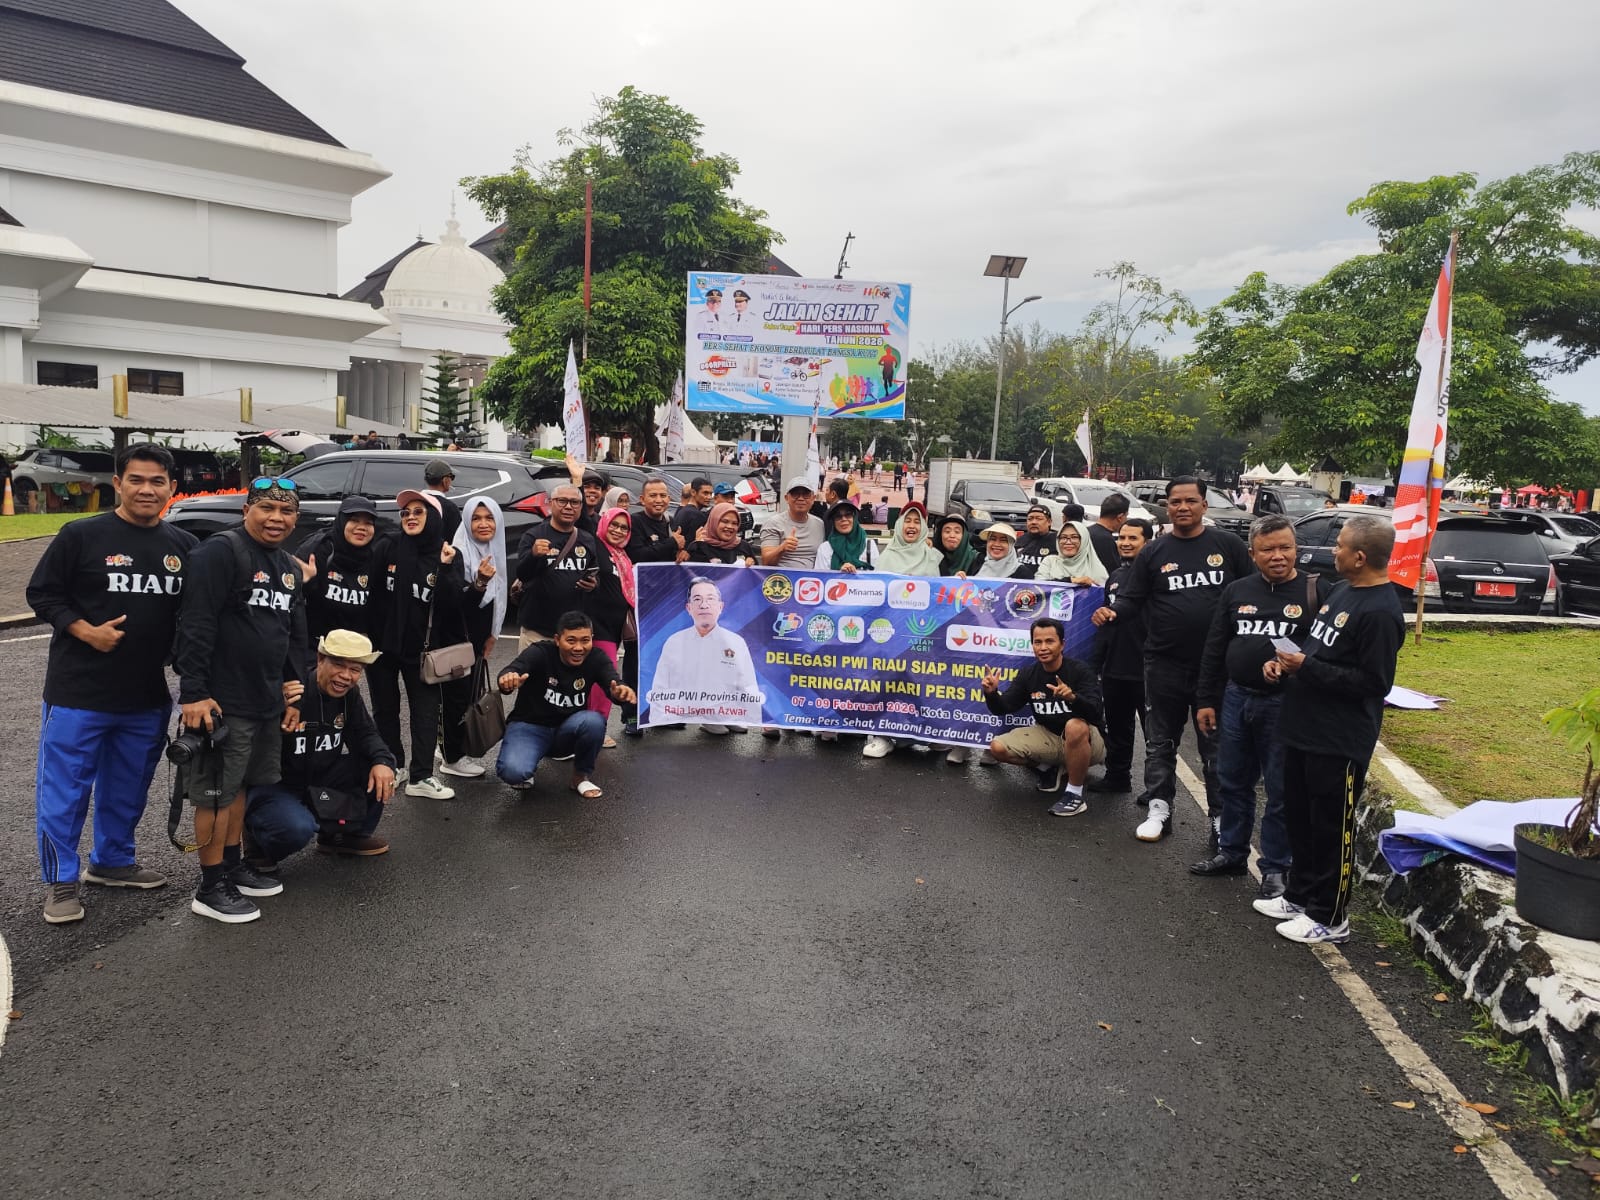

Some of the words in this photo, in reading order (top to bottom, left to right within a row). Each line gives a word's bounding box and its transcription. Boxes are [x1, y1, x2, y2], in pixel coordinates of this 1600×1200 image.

[763, 303, 821, 321] JALAN
[822, 303, 879, 322] SEHAT
[800, 324, 821, 334] HARI
[822, 324, 843, 334] PERS
[844, 324, 885, 334] NASIONAL
[724, 343, 748, 353] SEHAT
[825, 335, 856, 345] TAHUN
[858, 336, 884, 346] 2026
[107, 572, 183, 595] RIAU
[1167, 570, 1225, 591] RIAU
[248, 588, 292, 613] RA
[325, 583, 371, 606] RIAU
[848, 588, 882, 597] Minamas
[1236, 619, 1298, 637] RIAU
[908, 638, 934, 647] ASIAN
[910, 645, 931, 653] AGRI
[766, 651, 837, 668] DELEGASI
[841, 655, 868, 670] PWI
[872, 657, 907, 673] RIAU
[911, 660, 947, 676] SIAP
[650, 691, 676, 702] Ketua
[678, 690, 698, 701] PWI
[700, 691, 738, 702] Provinsi
[740, 692, 761, 703] Riau
[789, 674, 881, 693] PERINGATAN
[885, 681, 921, 696] HARI
[925, 684, 966, 700] PERS
[543, 688, 586, 708] RIAU
[664, 705, 685, 716] Raja
[688, 705, 715, 717] Isyam
[718, 706, 748, 717] Azwar
[791, 695, 806, 707] 07
[815, 698, 831, 709] 09
[832, 699, 884, 712] Februari
[886, 701, 920, 717] 2026,
[920, 706, 951, 719] Kota
[953, 709, 1003, 727] Serang,
[784, 713, 816, 725] Tema:
[817, 716, 840, 727] Pers
[842, 718, 876, 730] Sehat,
[878, 719, 922, 734] Ekonomi
[924, 726, 982, 743] Berdaulat,
